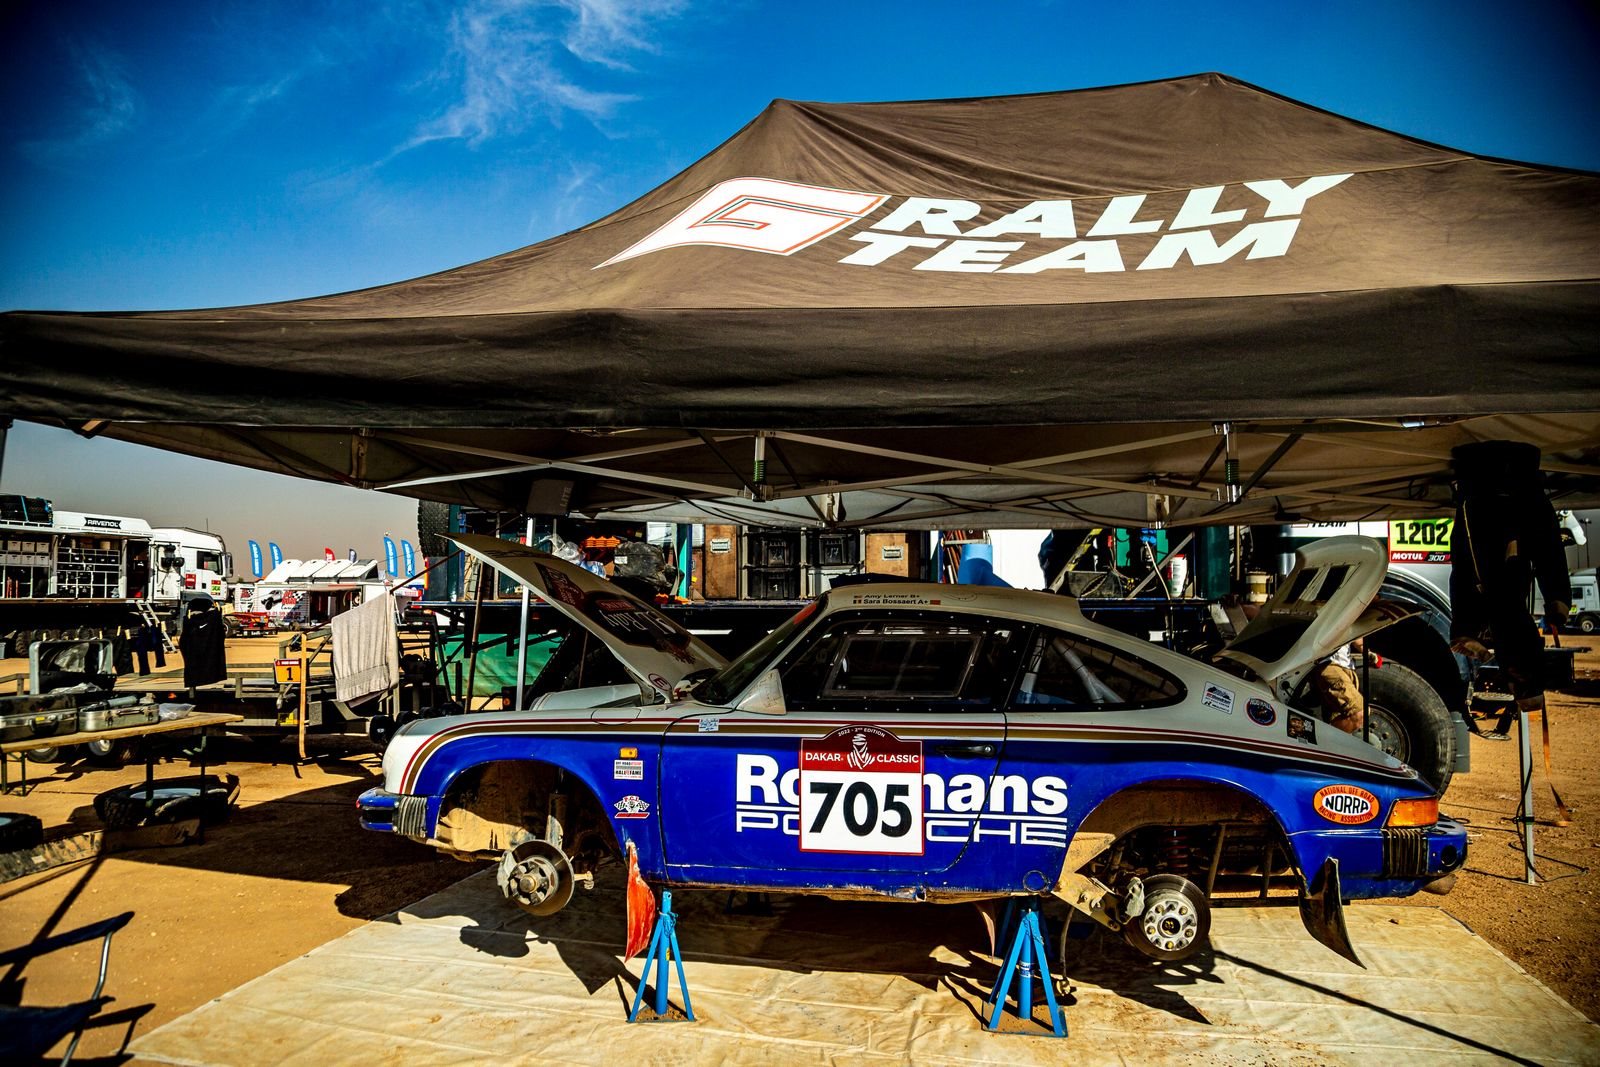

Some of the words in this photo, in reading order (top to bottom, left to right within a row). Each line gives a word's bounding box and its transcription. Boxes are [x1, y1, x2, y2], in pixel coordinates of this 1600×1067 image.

[869, 173, 1355, 238] RALLY
[837, 218, 1301, 274] TEAM
[87, 519, 119, 528] RAVENOL
[1395, 522, 1449, 546] 1202
[1392, 552, 1424, 560] MOTUL
[286, 667, 293, 681] 1
[838, 728, 851, 737] 2022
[863, 728, 885, 738] EDITION
[805, 752, 841, 761] DAKAR
[877, 754, 919, 763] CLASSIC
[1319, 786, 1346, 797] NATIONAL
[1348, 786, 1359, 795] OFF
[1360, 790, 1375, 803] ROAD
[809, 781, 912, 837] 705
[1325, 795, 1369, 814] NORRA
[1318, 805, 1337, 820] RACING
[1341, 810, 1374, 823] ASSOCIATION
